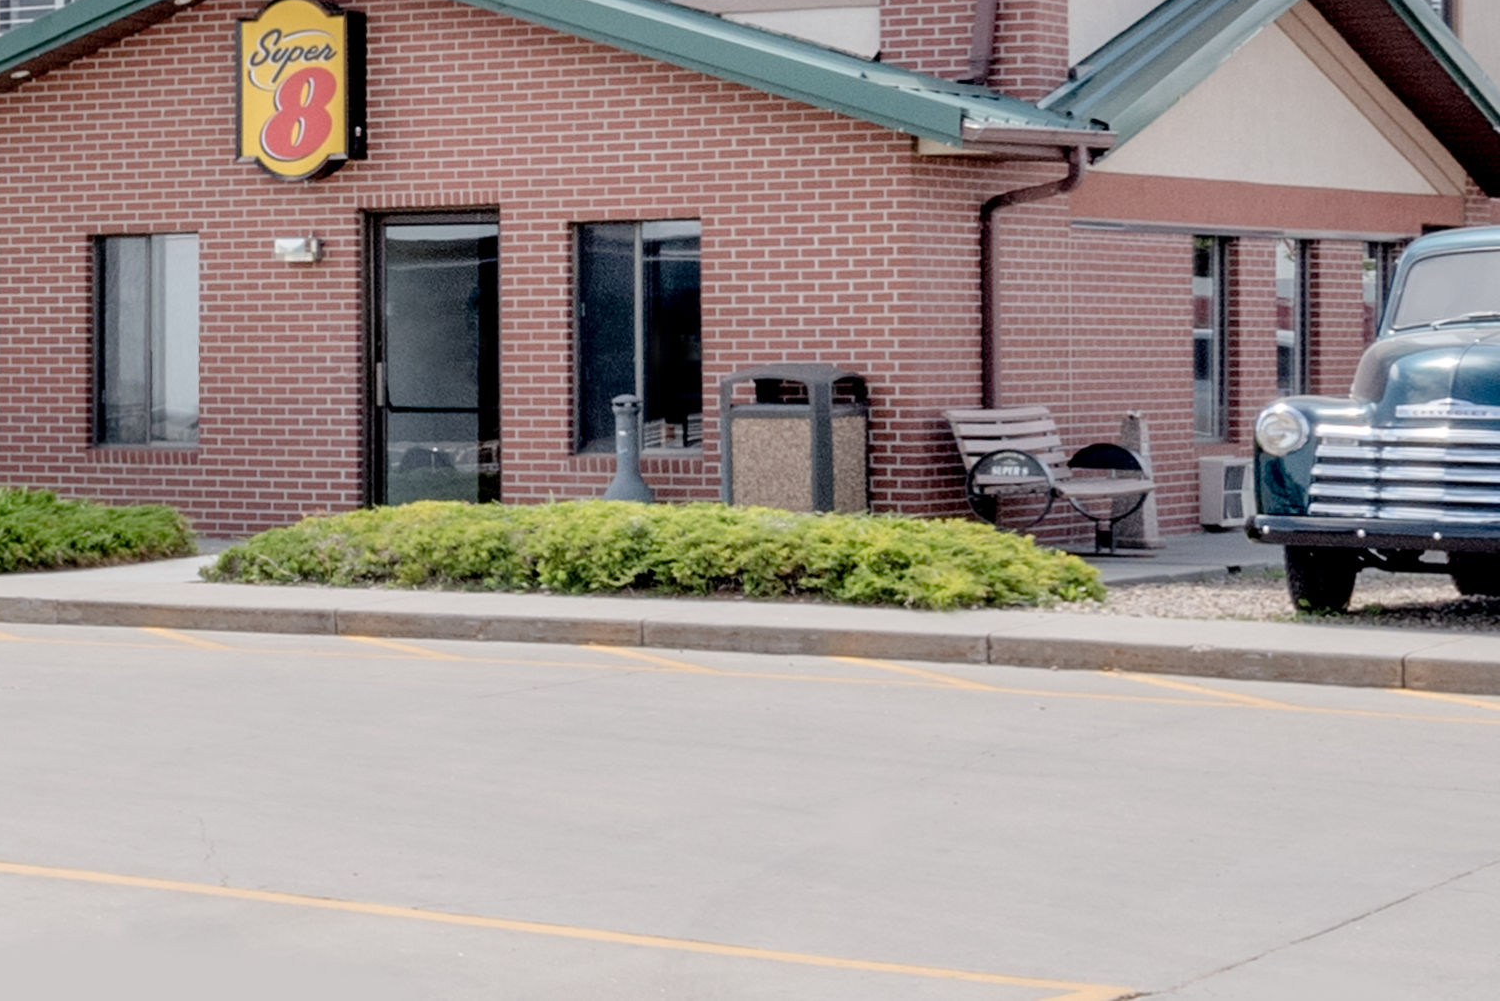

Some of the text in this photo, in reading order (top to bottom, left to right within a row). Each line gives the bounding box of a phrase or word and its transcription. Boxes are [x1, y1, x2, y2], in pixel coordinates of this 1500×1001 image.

[249, 28, 337, 84] Super
[260, 66, 337, 162] 8
[1412, 409, 1487, 417] CHEVROLET
